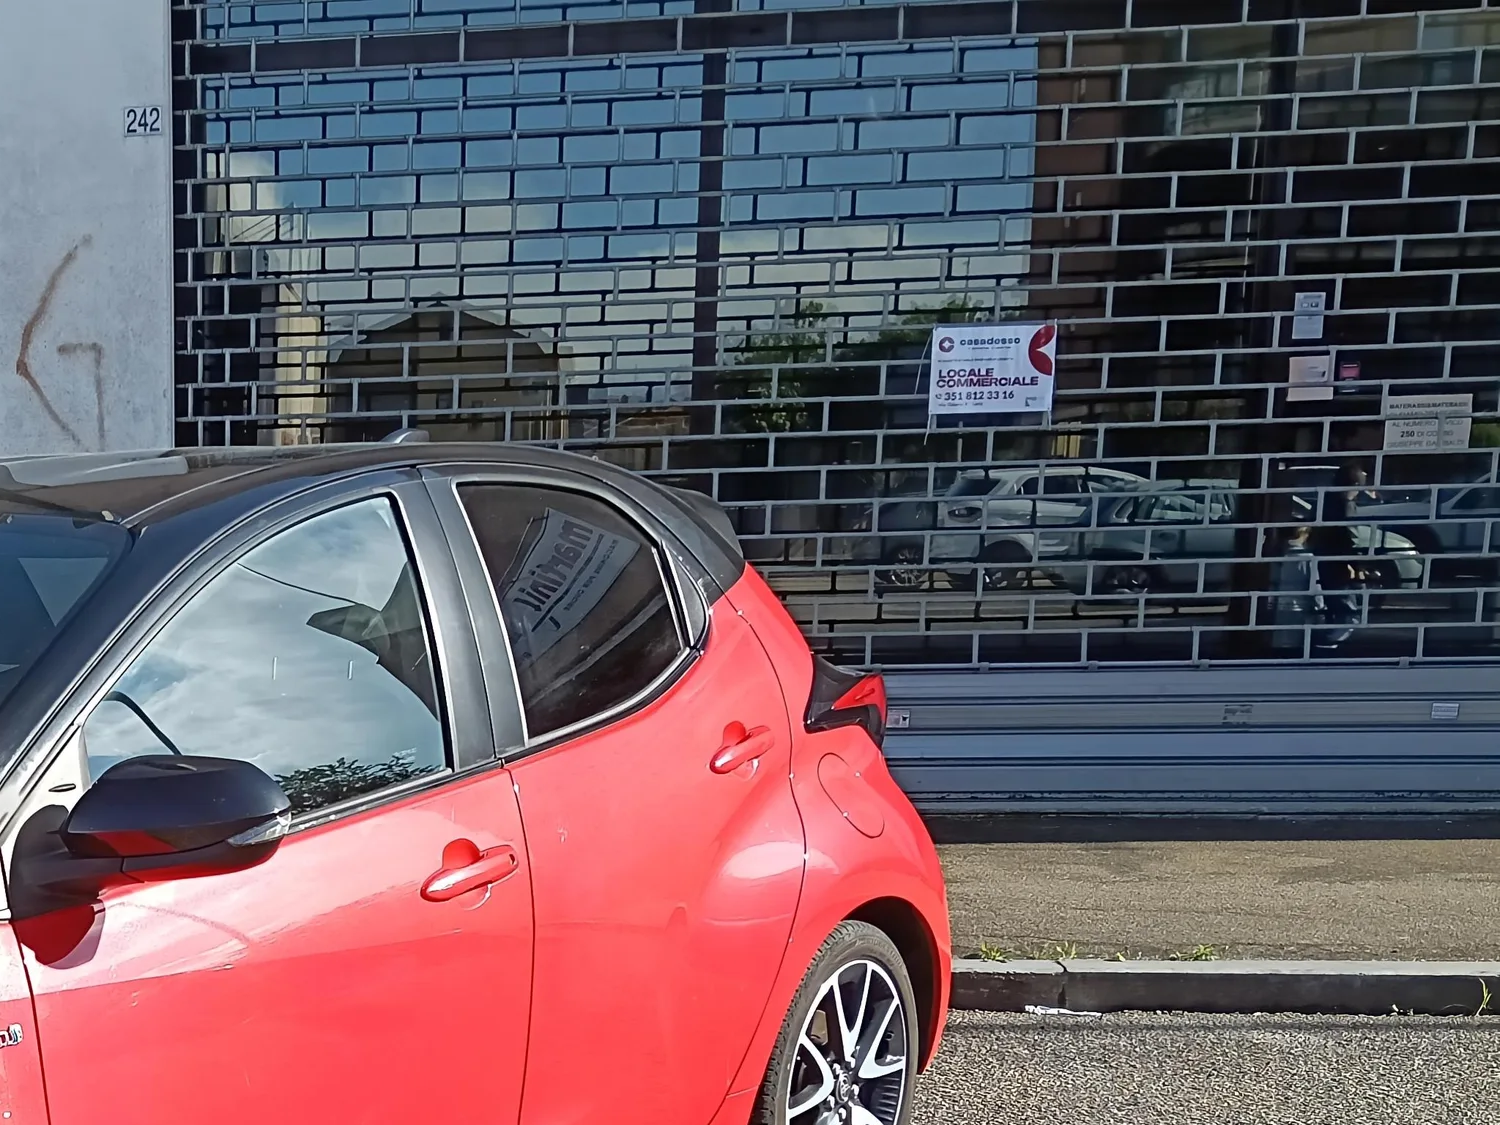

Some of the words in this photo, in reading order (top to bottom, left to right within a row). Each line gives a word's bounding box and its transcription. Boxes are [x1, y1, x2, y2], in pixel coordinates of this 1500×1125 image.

[127, 107, 160, 133] 242
[938, 368, 995, 378] LOCALE
[936, 376, 1039, 389] COMMERCIALE
[944, 391, 963, 401] 351
[965, 390, 985, 400] 812
[987, 390, 1000, 400] 33
[1002, 390, 1015, 399] 16
[1400, 430, 1415, 438] 250
